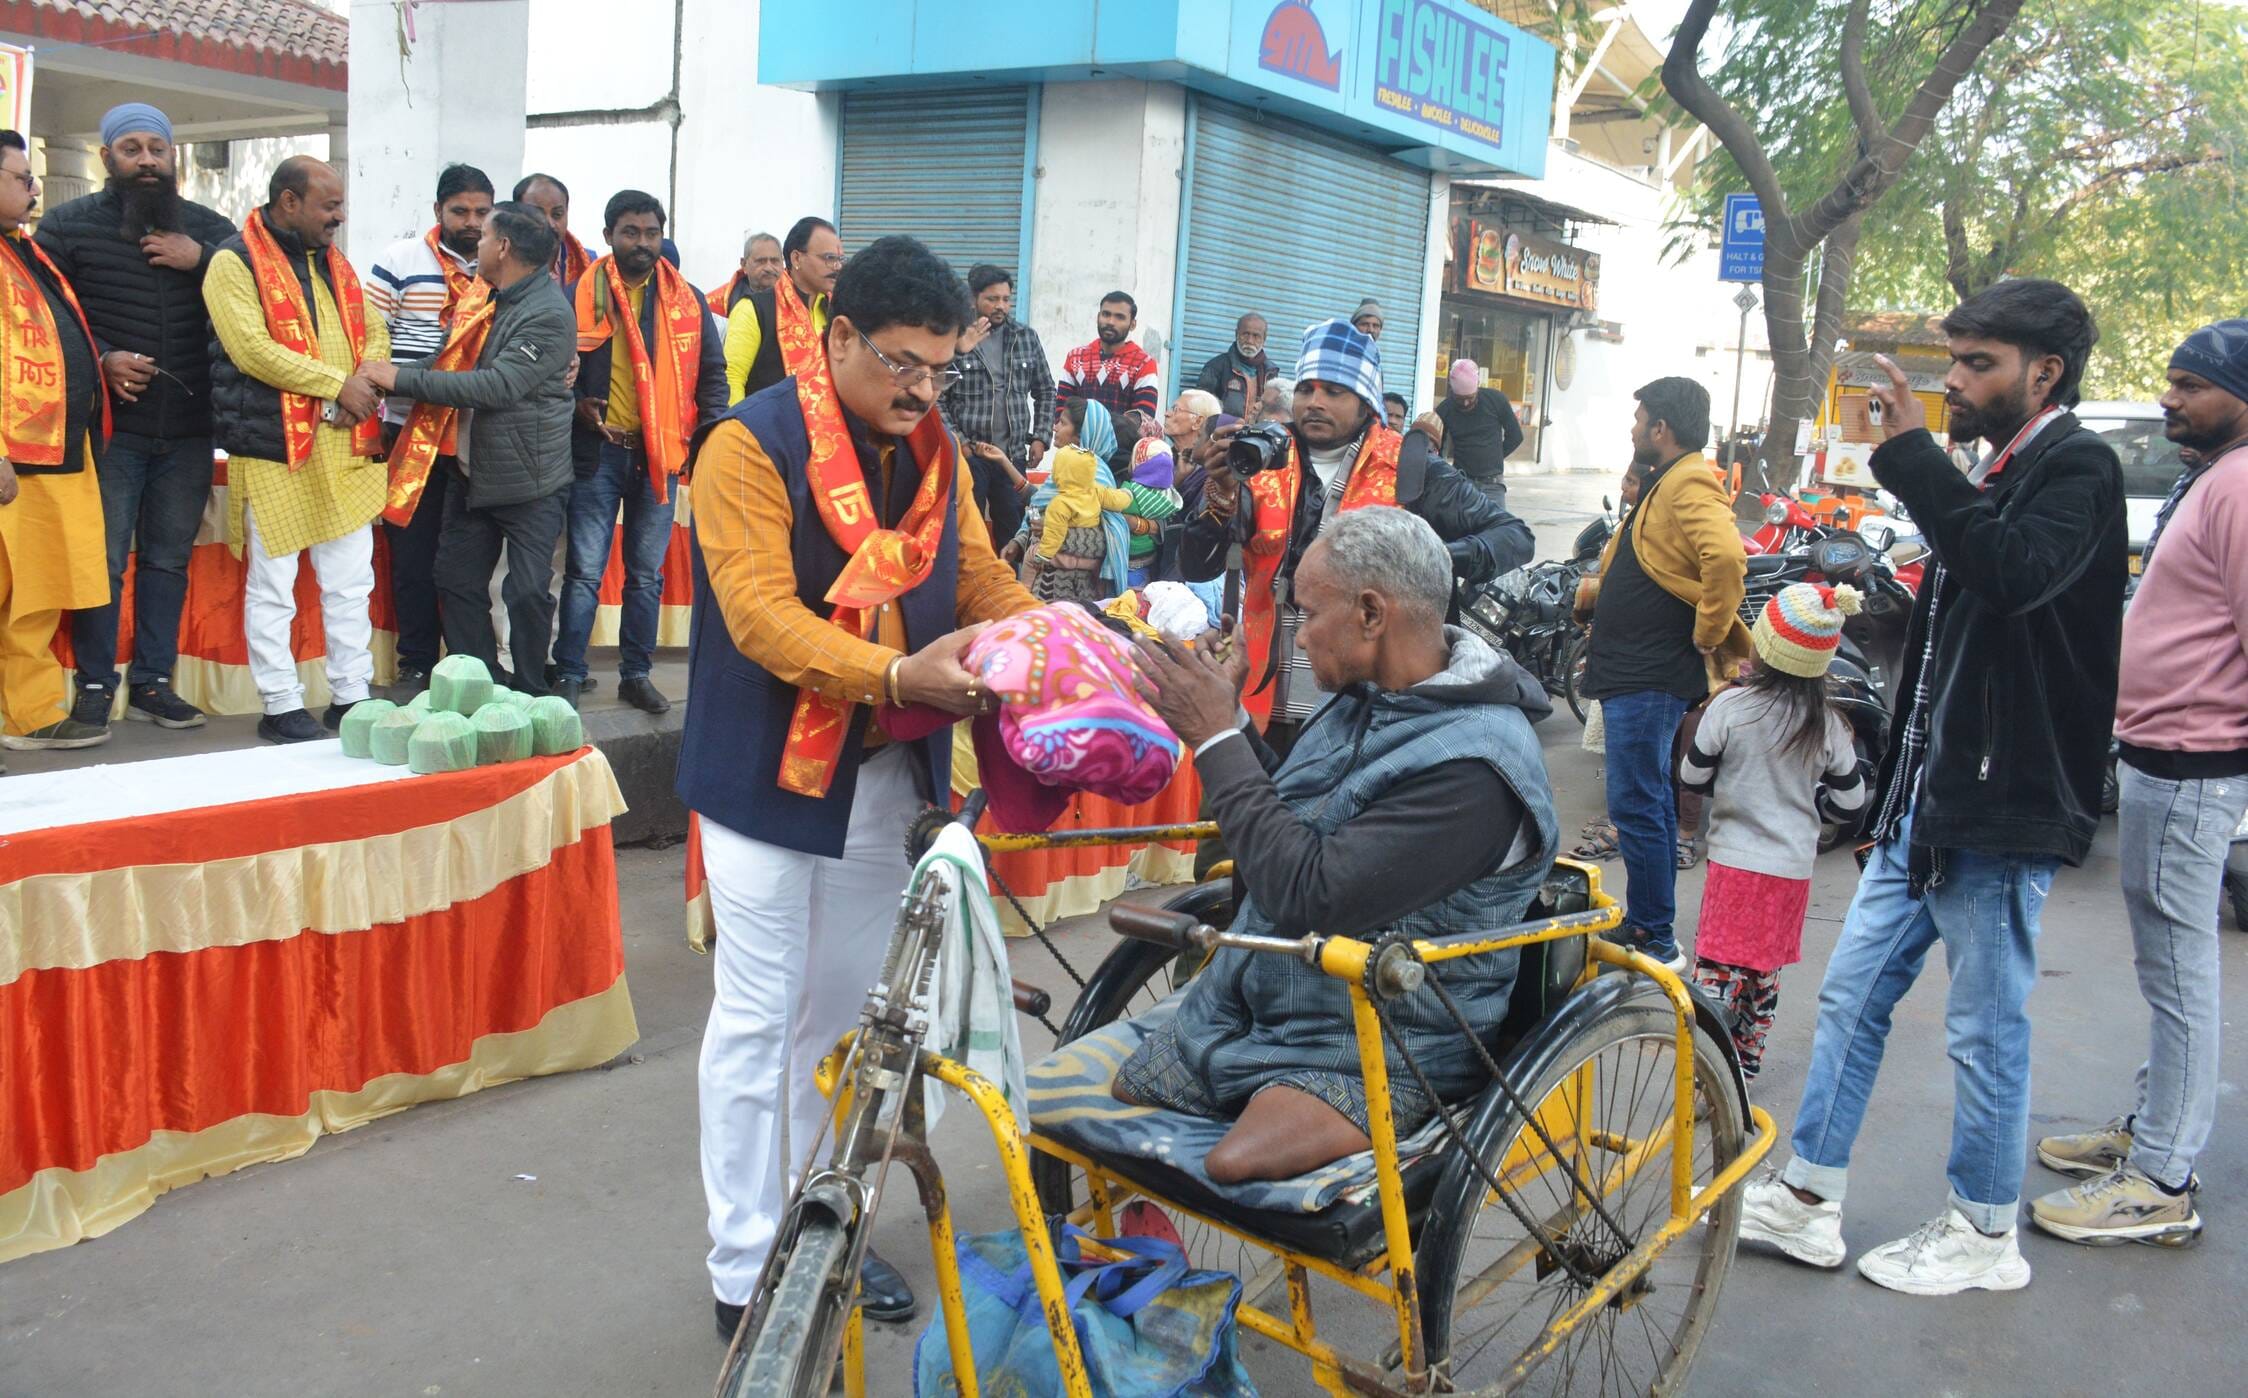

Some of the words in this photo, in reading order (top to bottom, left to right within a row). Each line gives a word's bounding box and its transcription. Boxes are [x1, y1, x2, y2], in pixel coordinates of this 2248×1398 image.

[1378, 0, 1506, 125] FISHLEE
[1520, 247, 1548, 273] Snow
[1550, 255, 1578, 280] White
[1727, 252, 1748, 261] HALT
[1729, 265, 1746, 273] FOR
